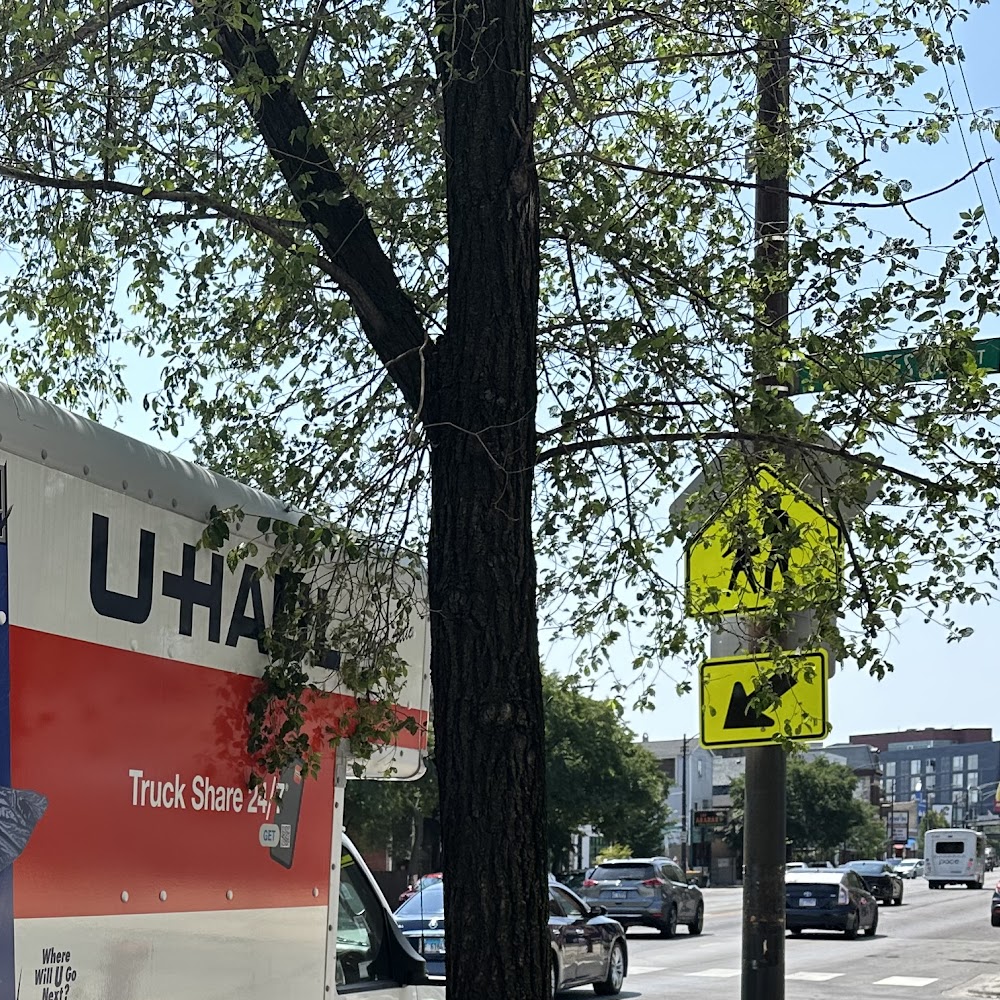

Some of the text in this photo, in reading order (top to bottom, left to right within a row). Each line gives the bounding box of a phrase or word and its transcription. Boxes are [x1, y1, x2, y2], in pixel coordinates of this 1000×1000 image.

[128, 768, 187, 810] Truck
[191, 774, 244, 814] Share
[262, 829, 276, 842] GET
[42, 947, 71, 965] Where
[35, 966, 77, 988] Will U Go
